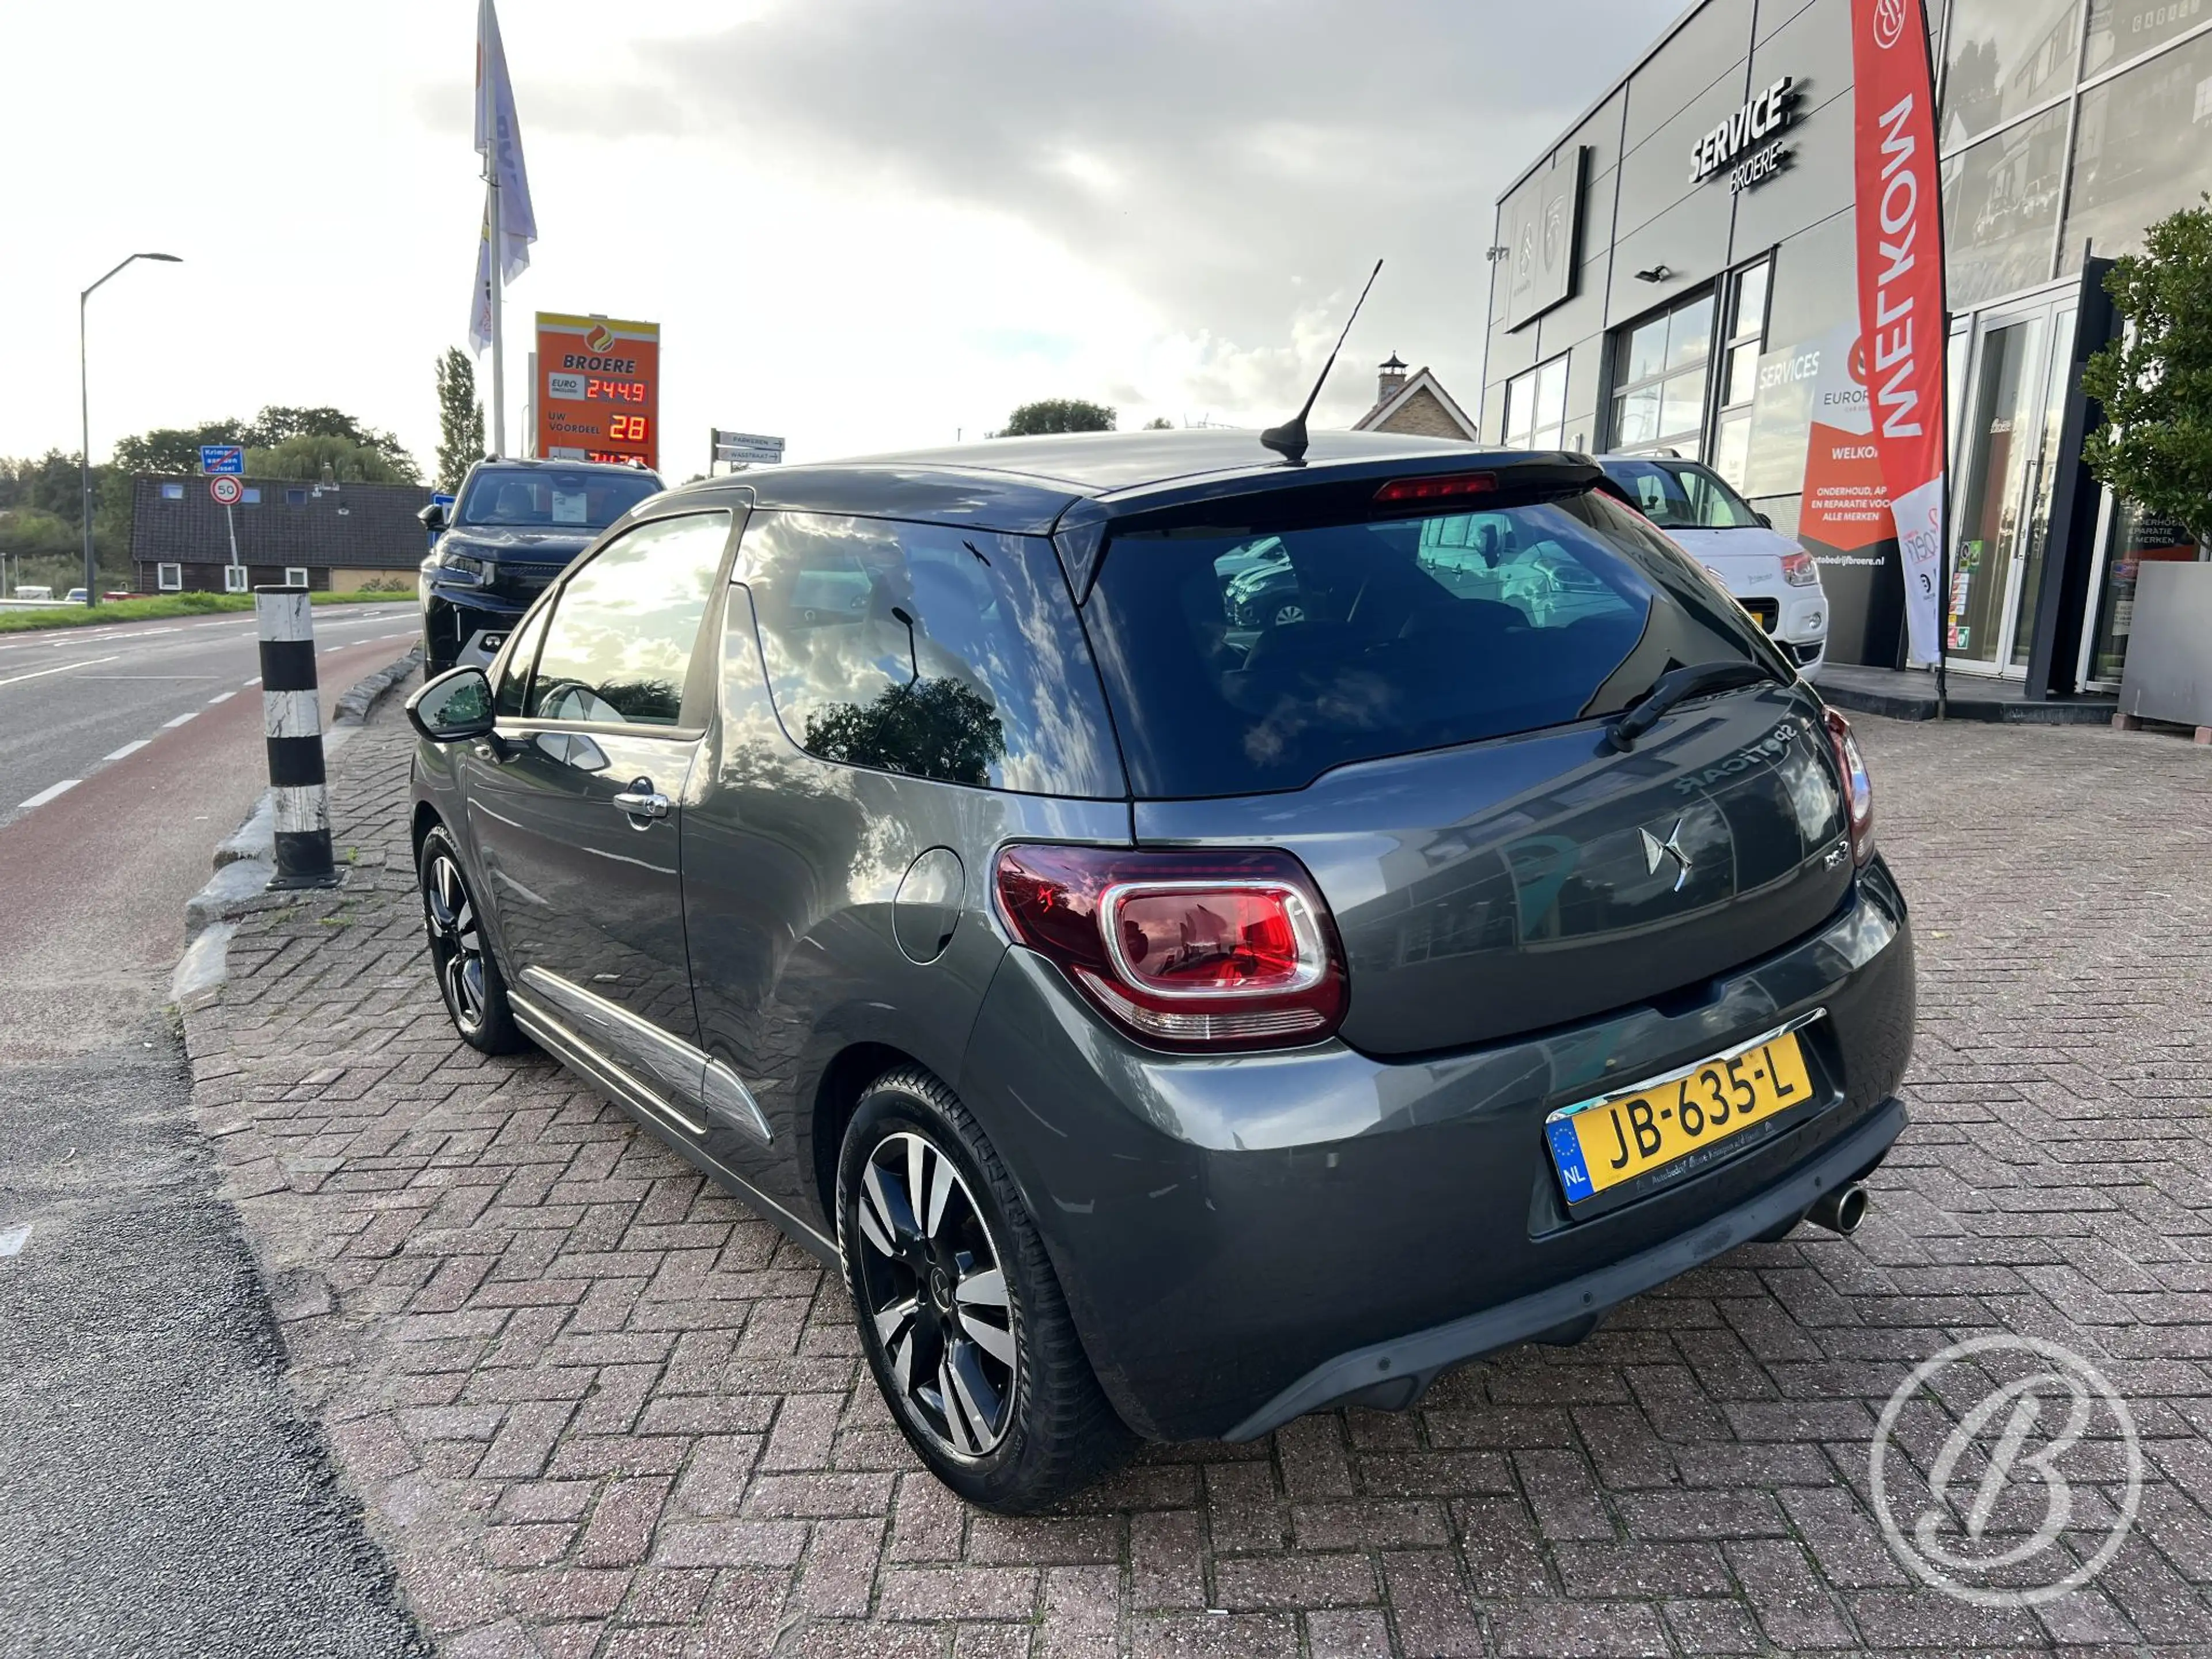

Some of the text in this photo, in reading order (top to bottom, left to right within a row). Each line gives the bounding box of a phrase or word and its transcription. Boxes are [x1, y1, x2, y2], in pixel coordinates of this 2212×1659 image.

[1688, 77, 1785, 183] SERVICE
[1730, 142, 1780, 195] BROERE
[563, 354, 635, 374] BROERE
[1759, 351, 1820, 389] SERVICES
[548, 411, 566, 421] UW
[550, 414, 646, 440] VOORDEEL 28
[218, 485, 234, 494] 50
[1811, 499, 1823, 509] EN
[1824, 499, 1868, 509] REPARATIE
[1822, 512, 1880, 521] ALLE MERKEN
[1610, 1046, 1795, 1170] JB-635-L
[1563, 1165, 1586, 1188] NL
